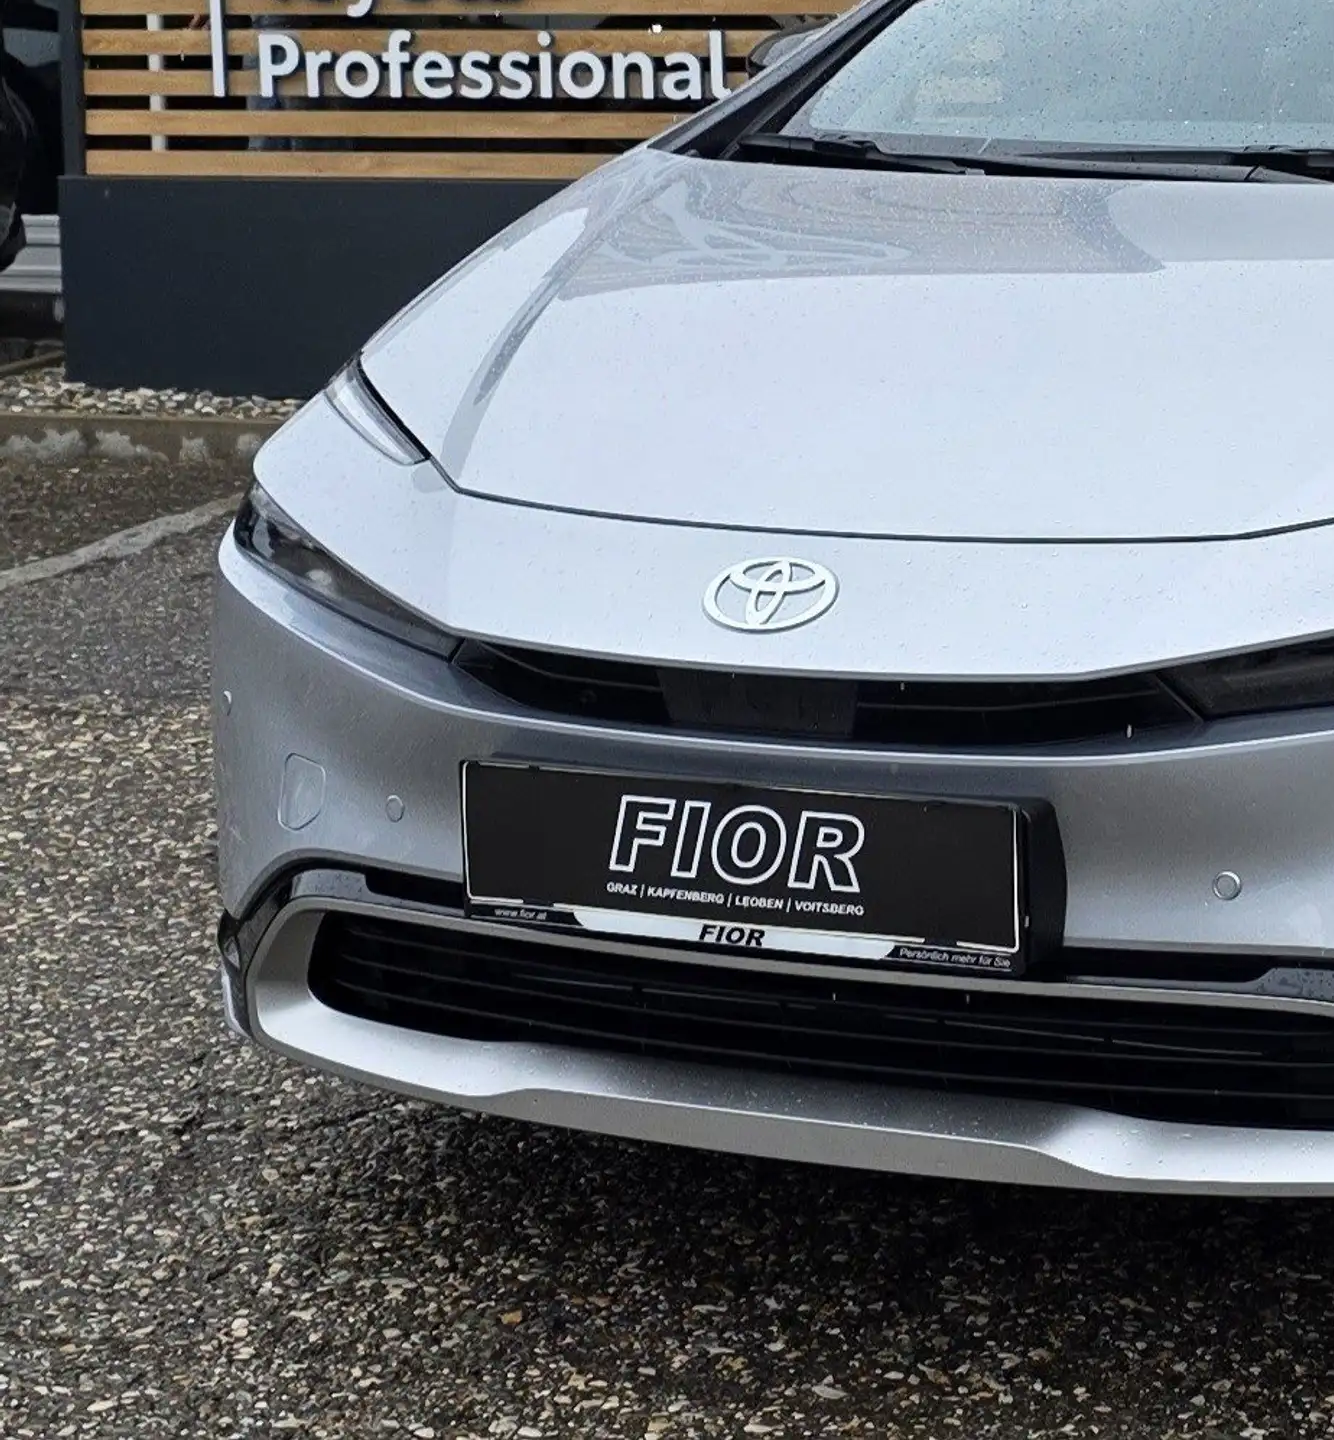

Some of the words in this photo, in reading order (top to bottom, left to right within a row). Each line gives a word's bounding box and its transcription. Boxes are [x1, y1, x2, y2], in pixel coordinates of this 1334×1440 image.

[258, 30, 731, 101] Professional
[608, 793, 865, 893] FIOR
[606, 881, 637, 897] GRAZ
[647, 885, 725, 905] KAPFENBERG
[735, 895, 784, 910] LEOBEN
[794, 899, 865, 916] VOITSBERG
[698, 923, 766, 947] FIOR
